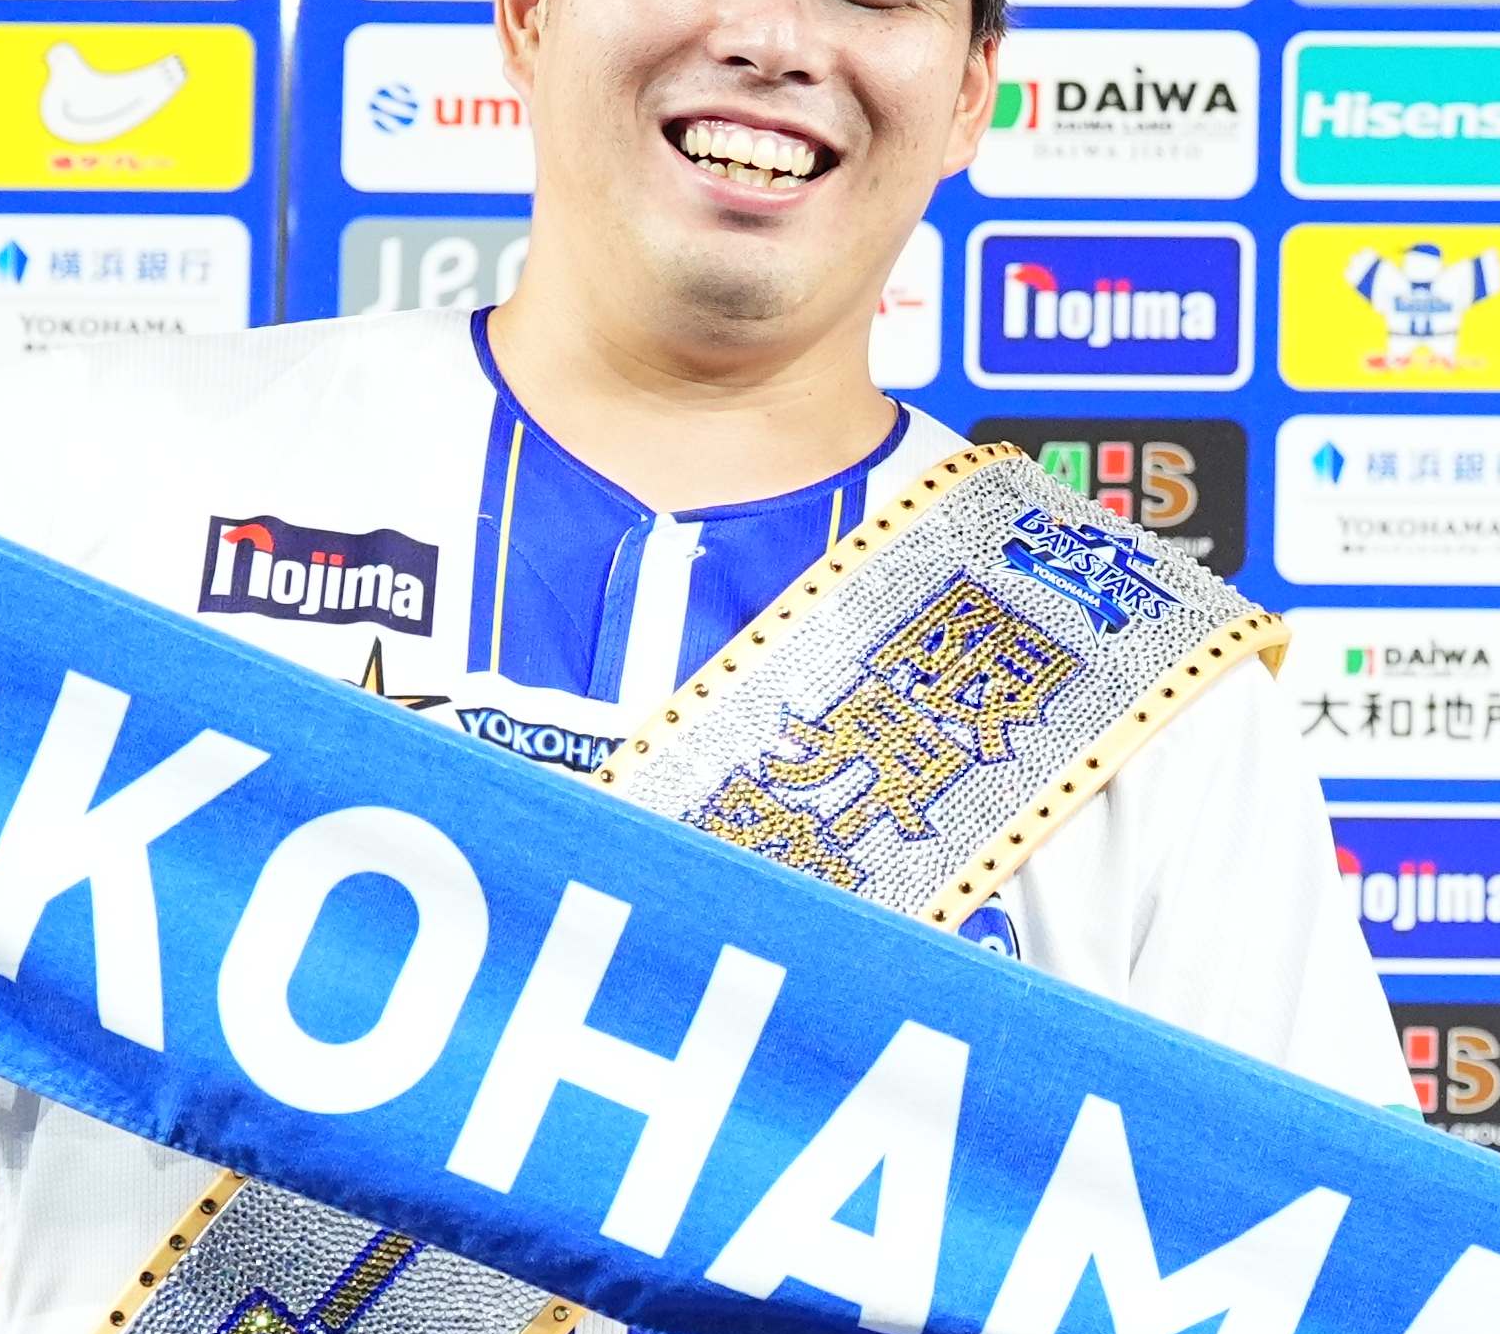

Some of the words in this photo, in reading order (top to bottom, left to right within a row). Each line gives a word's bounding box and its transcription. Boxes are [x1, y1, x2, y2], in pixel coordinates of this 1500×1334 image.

[1010, 506, 1173, 623] BAYSTARS
[1031, 562, 1101, 608] YOKOHAMA
[463, 710, 624, 769] YOKOHA
